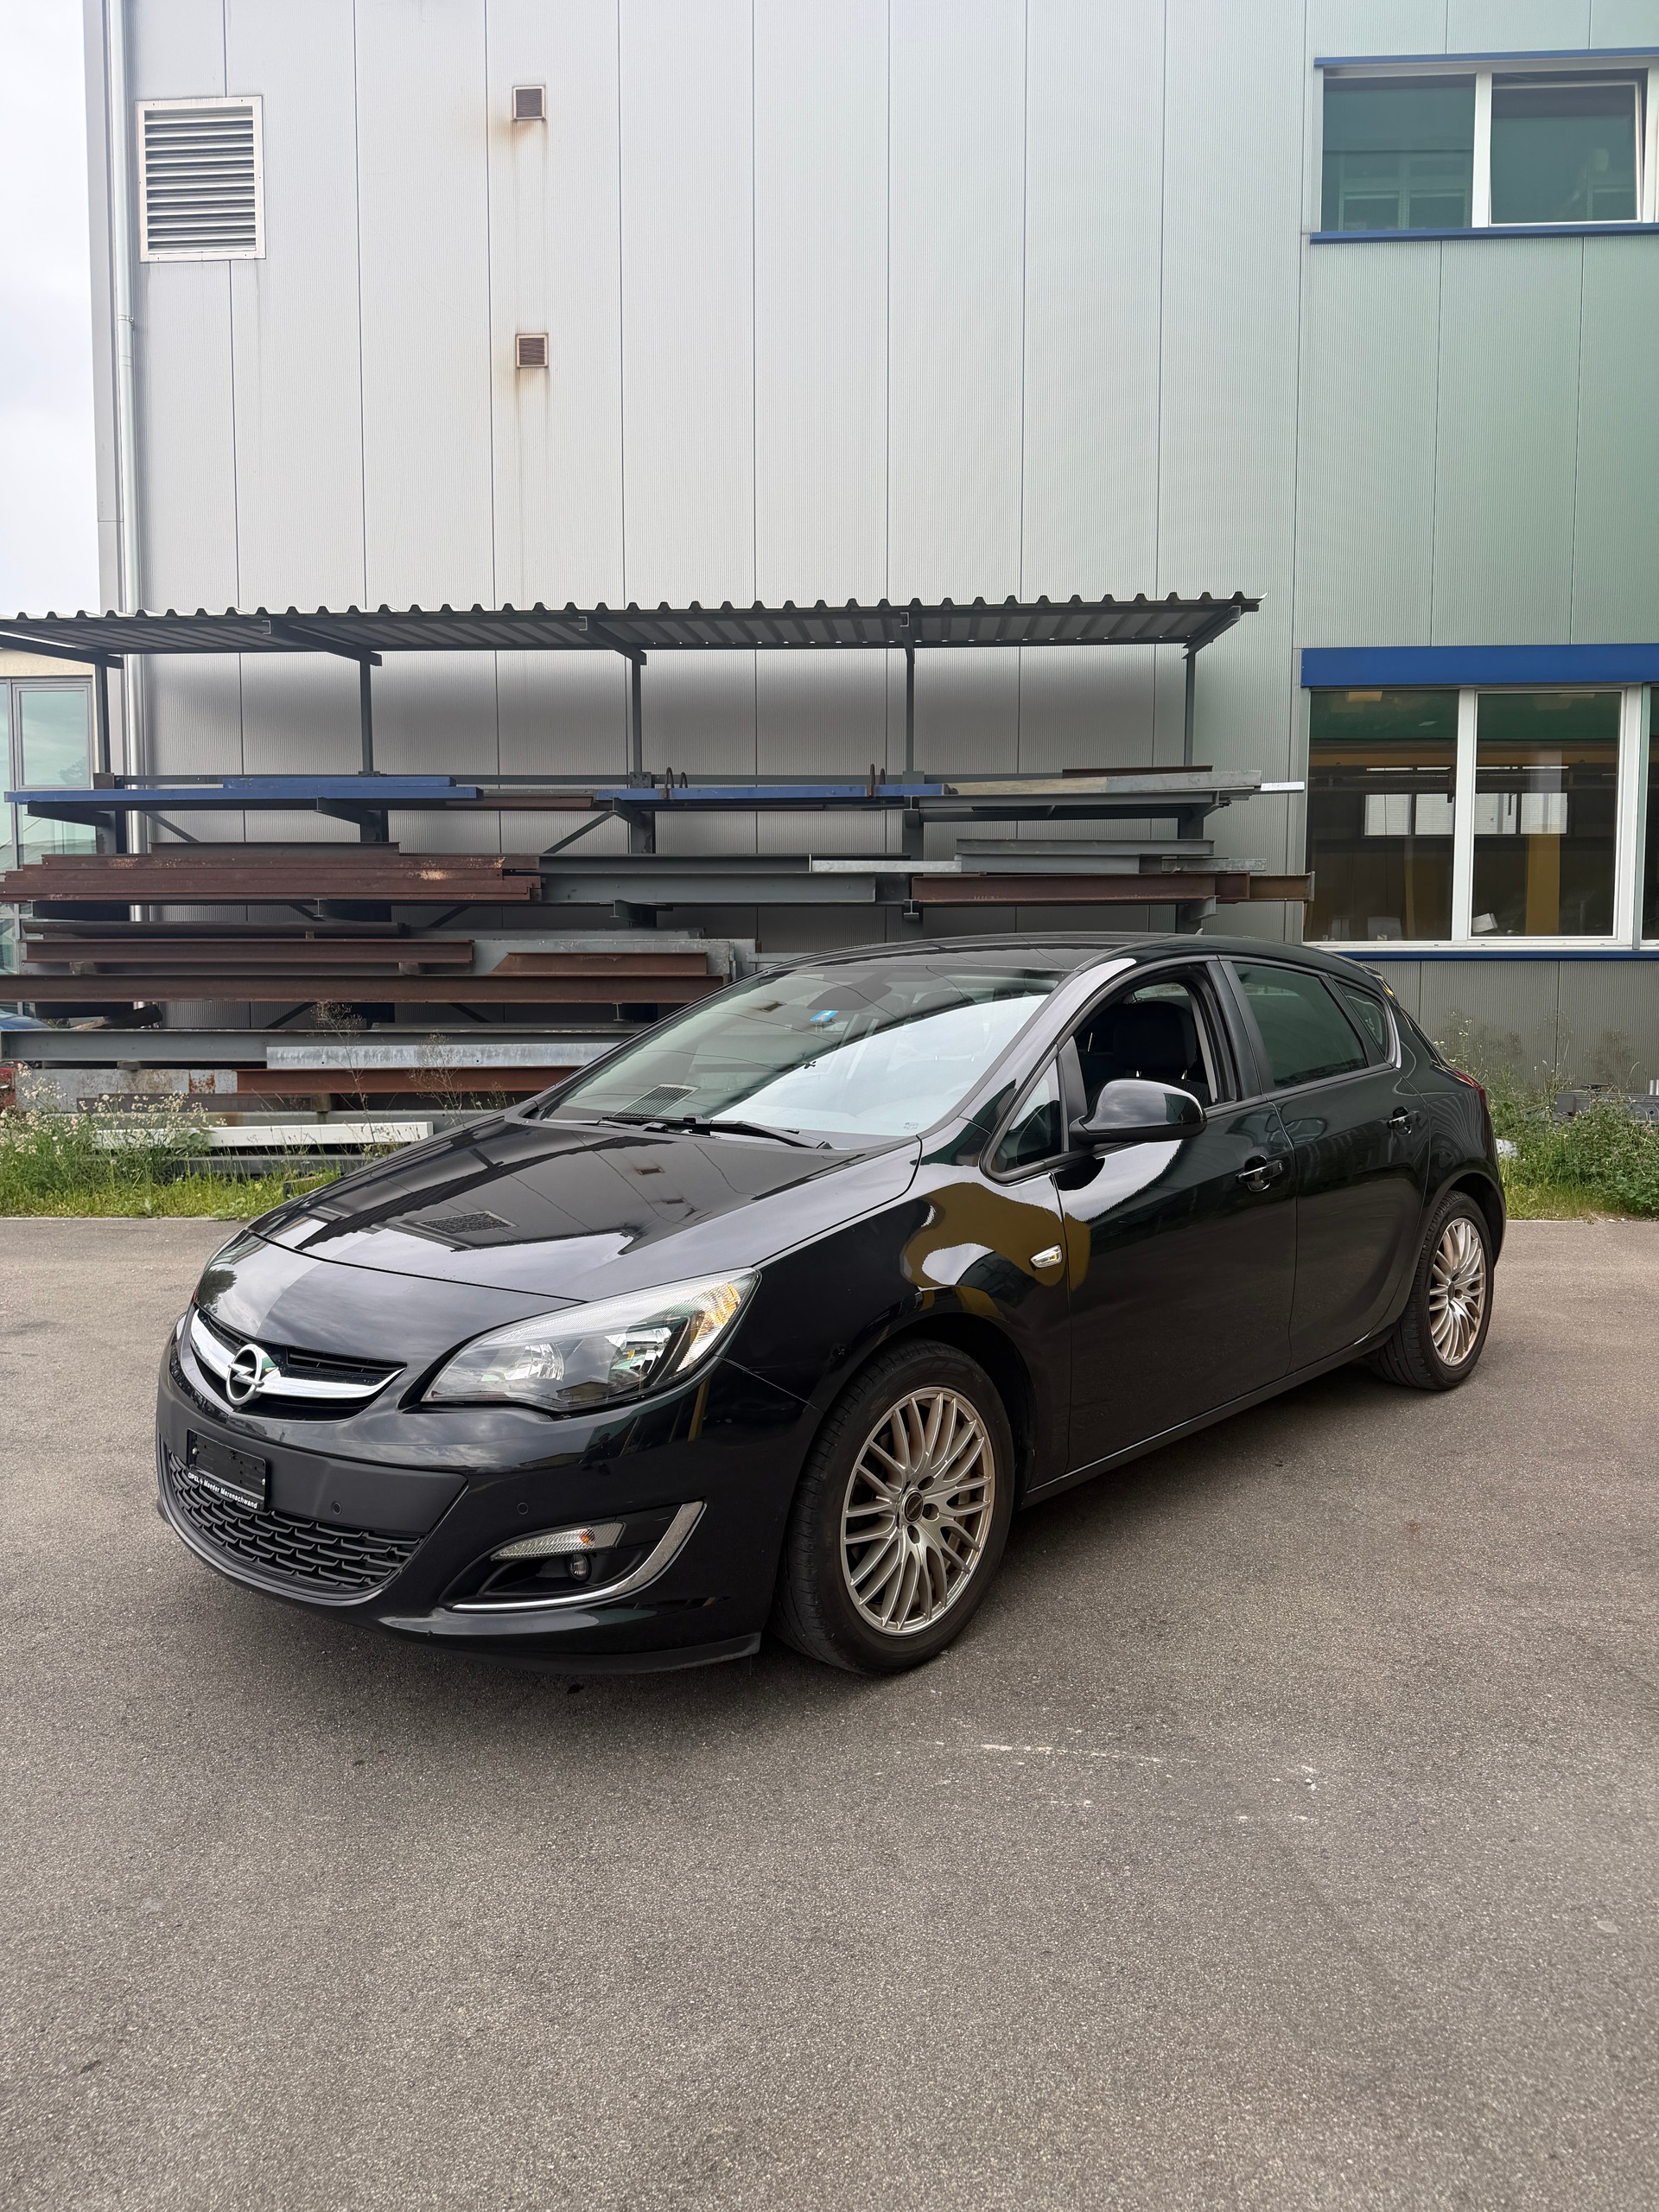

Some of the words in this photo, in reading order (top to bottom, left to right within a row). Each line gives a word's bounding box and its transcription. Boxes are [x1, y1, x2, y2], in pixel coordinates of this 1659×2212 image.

[188, 1472, 200, 1484] OPEL
[203, 1479, 220, 1493] Maeder
[220, 1488, 258, 1510] Merenschwand
